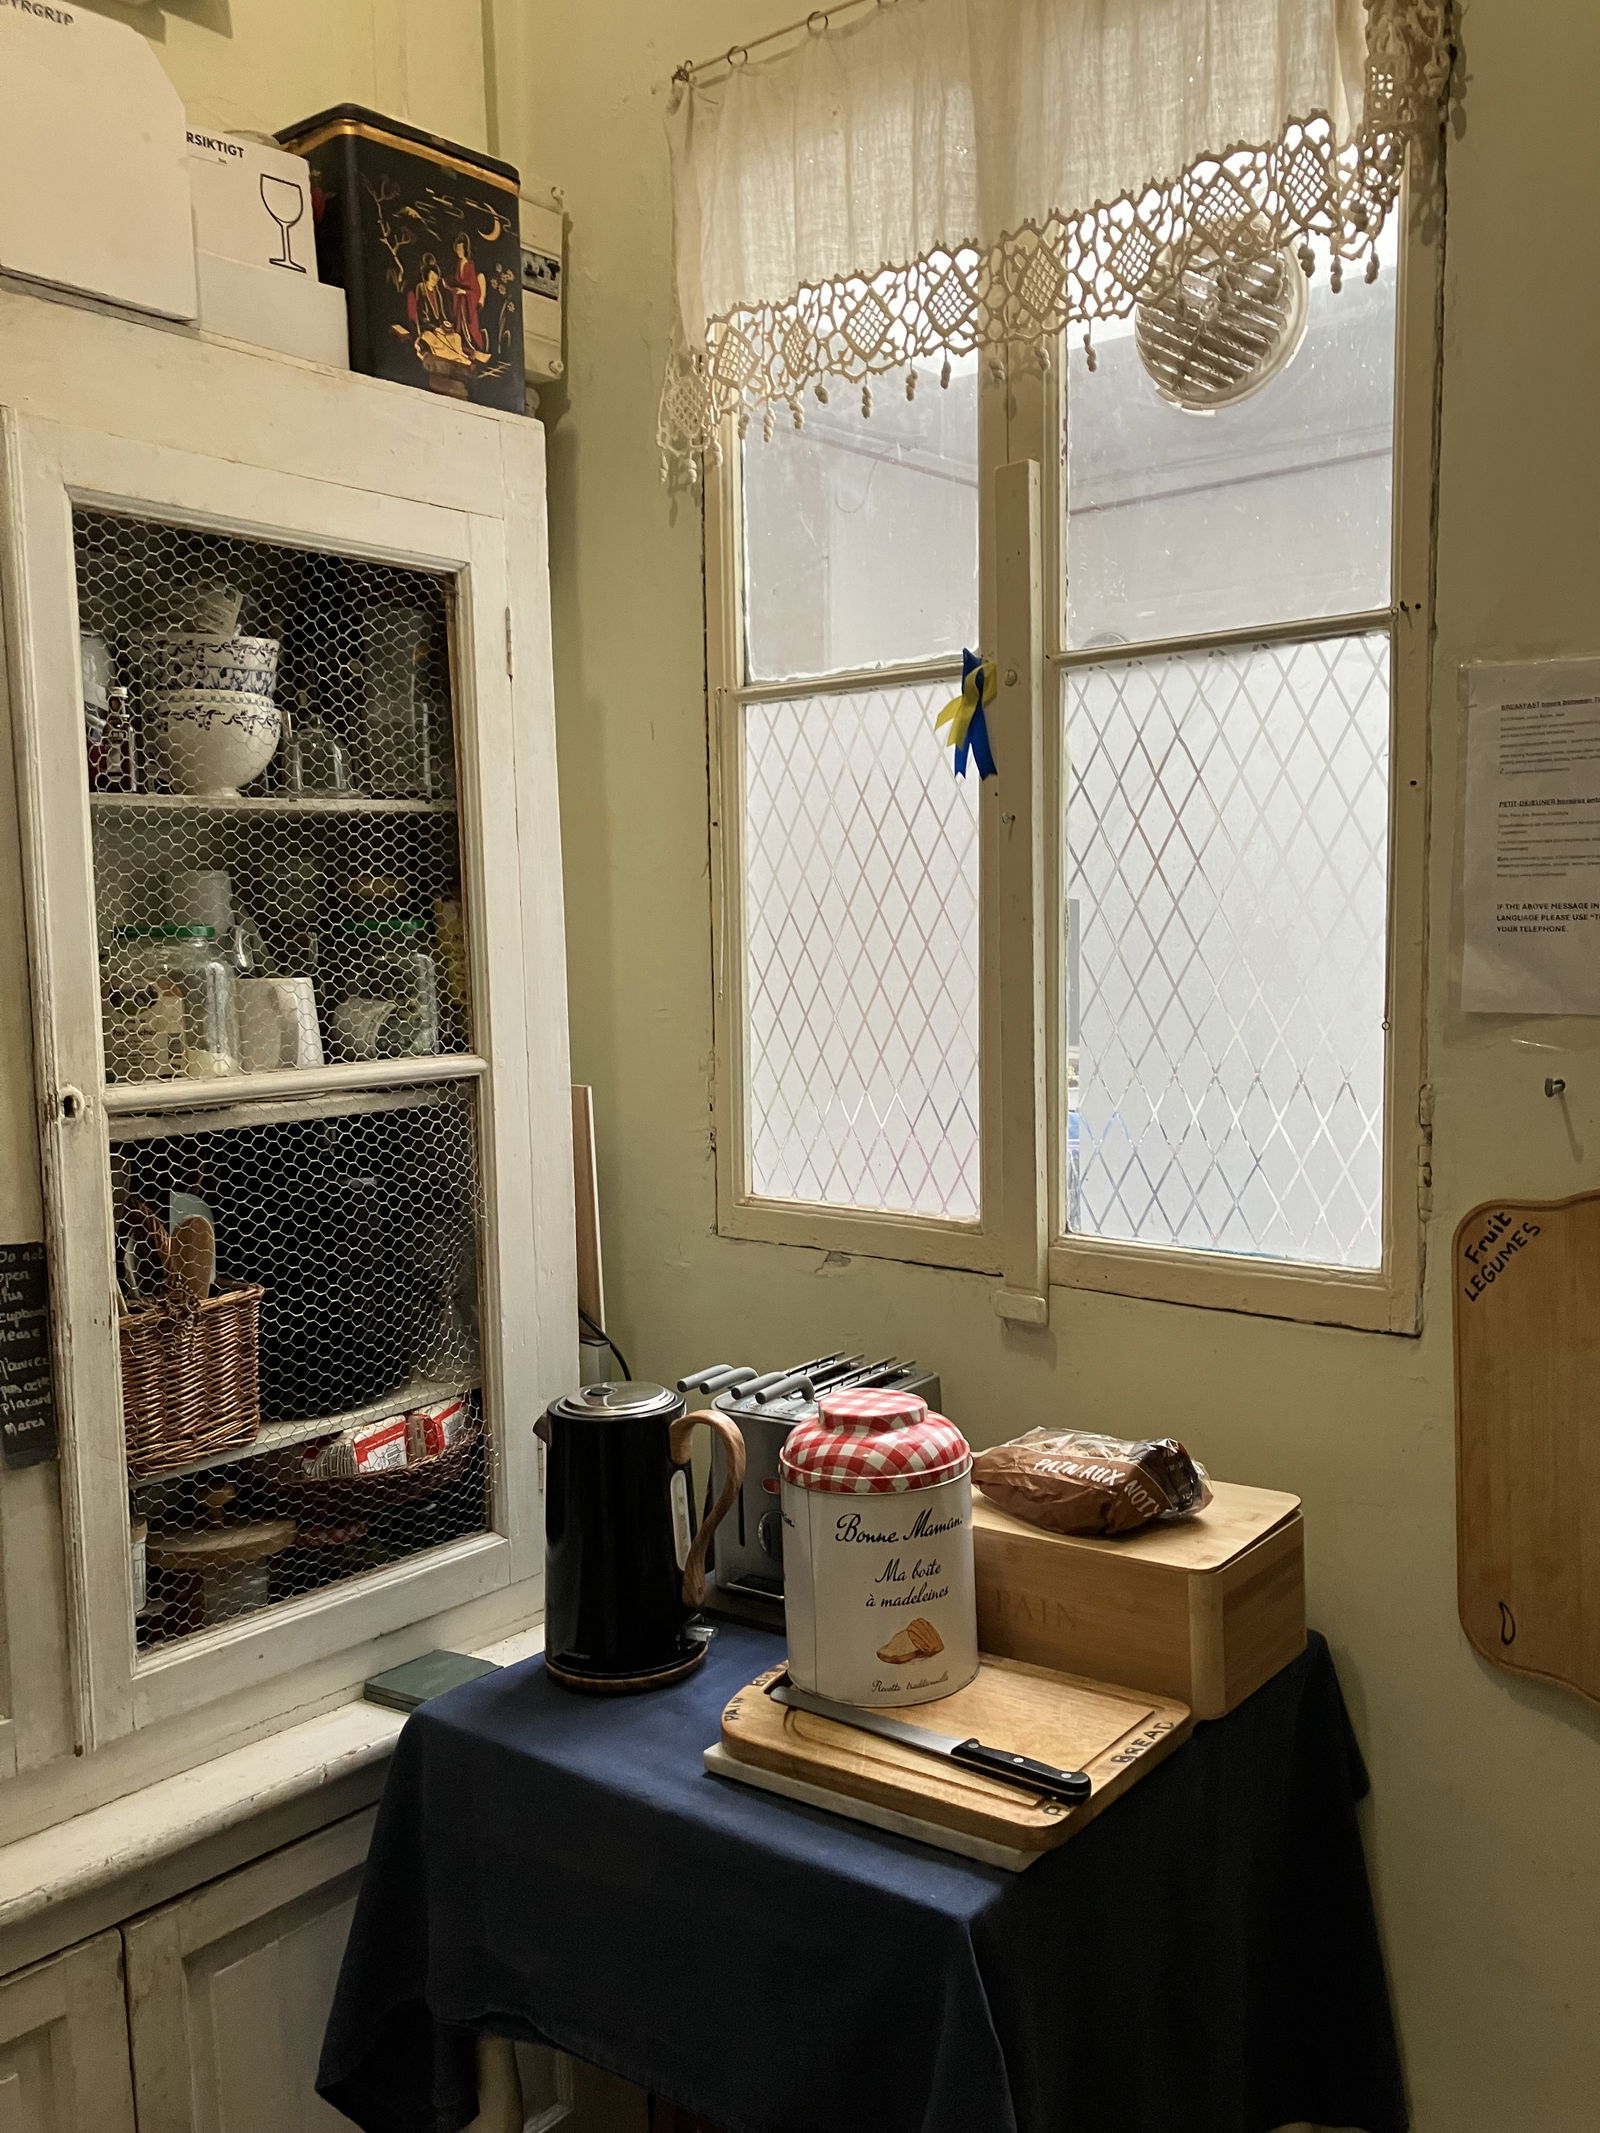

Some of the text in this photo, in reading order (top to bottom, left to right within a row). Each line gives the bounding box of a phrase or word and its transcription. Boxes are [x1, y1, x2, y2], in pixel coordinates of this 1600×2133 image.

[186, 131, 244, 158] RSIKTIGT
[1496, 914, 1538, 922] LANGUAGE
[1496, 925, 1518, 933] YOUR
[1464, 1212, 1512, 1264] Fruit
[1464, 1222, 1541, 1302] LEGUMES
[1034, 1458, 1081, 1476] PAIN
[1079, 1464, 1126, 1486] AUX
[835, 1512, 899, 1543] Bonne
[874, 1558, 906, 1583] Ma
[880, 1581, 949, 1608] madeleines
[1110, 1720, 1176, 1764] BREAD
